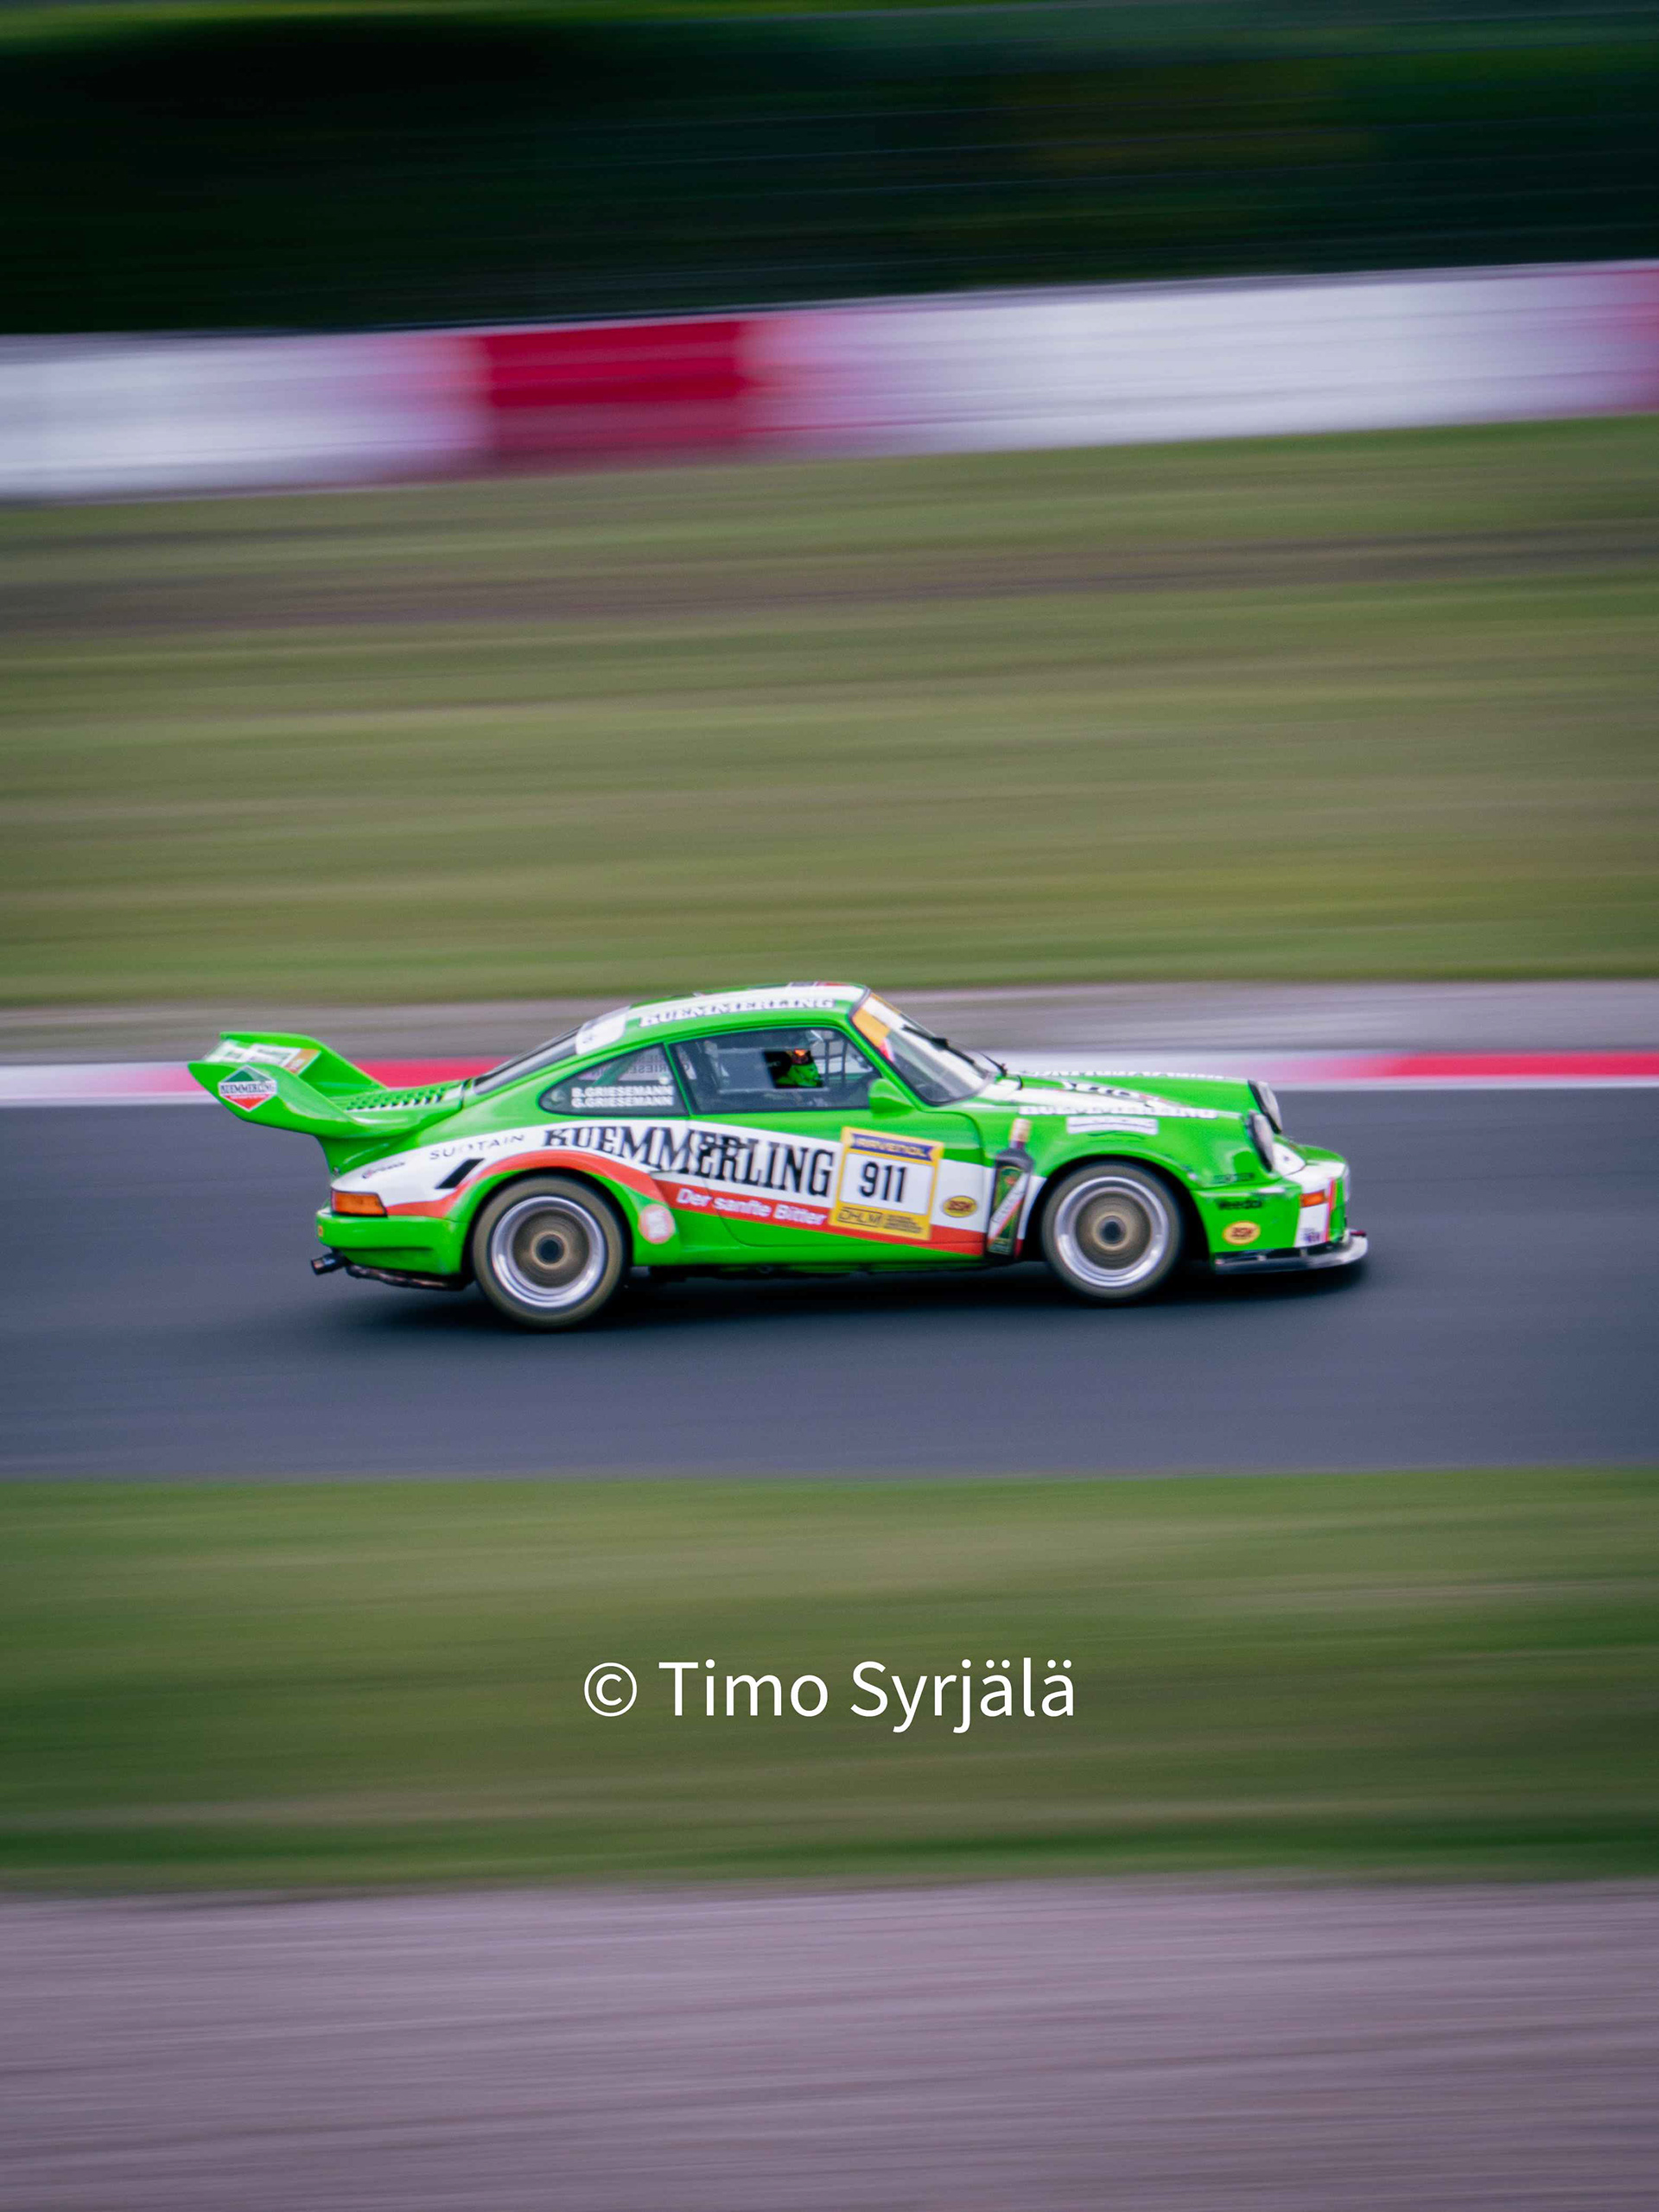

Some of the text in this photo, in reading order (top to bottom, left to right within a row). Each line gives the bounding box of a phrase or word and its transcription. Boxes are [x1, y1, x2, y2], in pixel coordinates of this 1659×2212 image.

[542, 1125, 836, 1198] KUEMMERLING
[858, 1161, 906, 1203] 911
[676, 1187, 711, 1207] Der
[772, 1202, 827, 1226] Bitter
